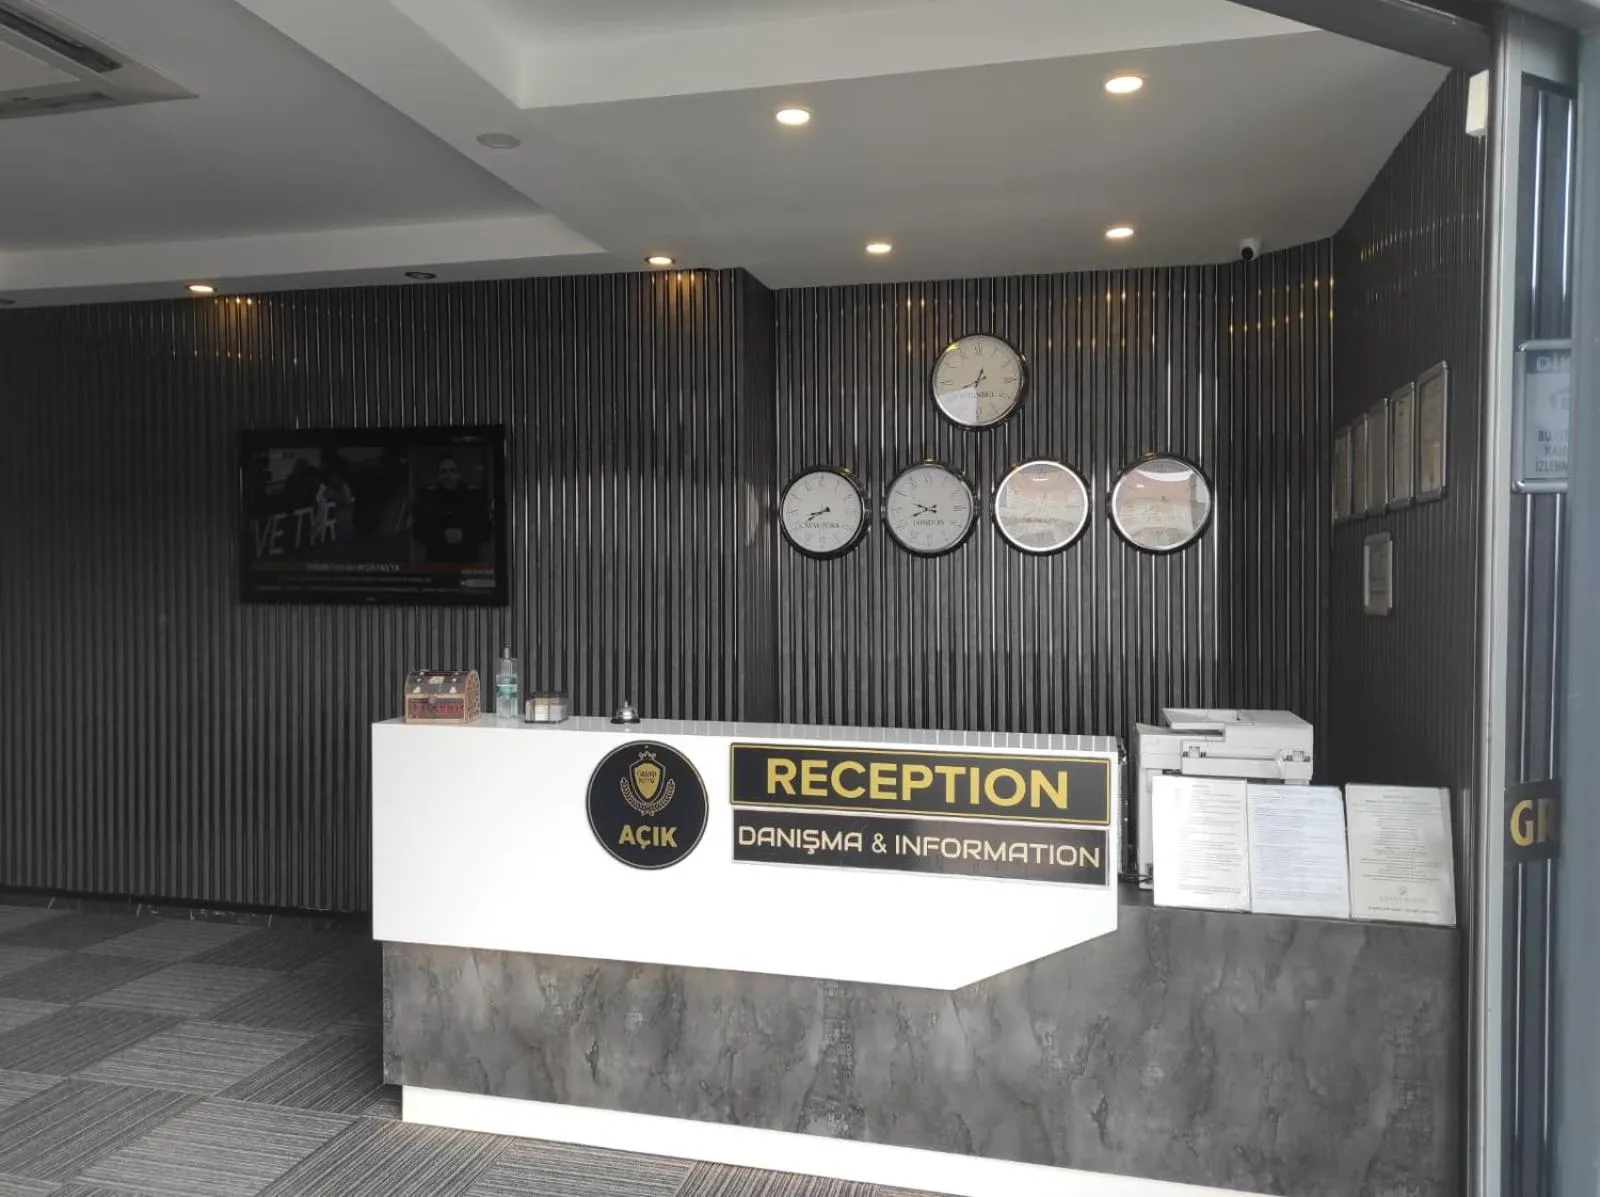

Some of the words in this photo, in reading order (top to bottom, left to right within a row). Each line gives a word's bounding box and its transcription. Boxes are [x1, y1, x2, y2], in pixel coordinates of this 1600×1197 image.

[767, 758, 1068, 809] RECEPTION
[618, 824, 678, 850] AÇIK
[738, 826, 862, 854] DANIŞMA
[871, 833, 887, 854] &
[896, 835, 1100, 868] INFORMATION
